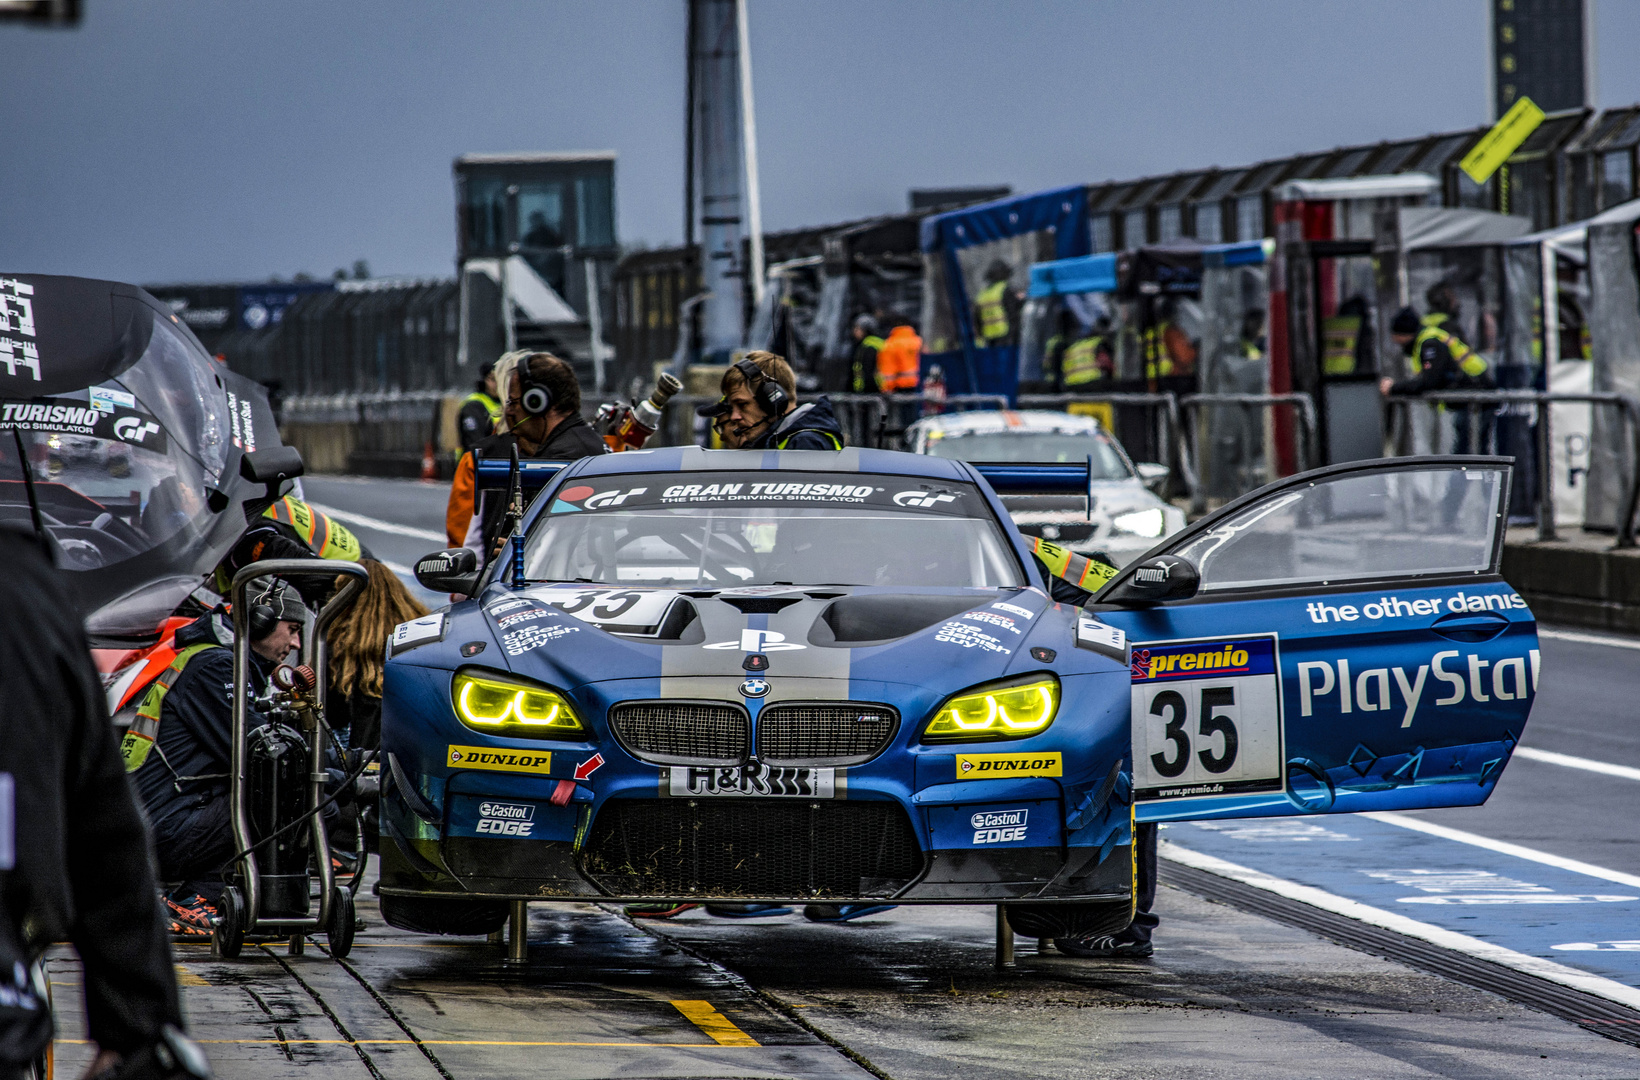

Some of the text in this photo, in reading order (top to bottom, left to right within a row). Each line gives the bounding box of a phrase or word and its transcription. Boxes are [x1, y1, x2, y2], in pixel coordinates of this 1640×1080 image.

[32, 422, 94, 435] SIMULATOR
[662, 483, 744, 498] GRAN
[786, 495, 865, 503] SIMULATOR
[550, 590, 658, 619] 35
[1307, 602, 1360, 624] the
[1362, 597, 1442, 620] other
[502, 625, 539, 640] the
[504, 624, 562, 645] other
[941, 625, 1001, 643] other
[946, 621, 982, 633] the
[506, 627, 580, 650] danish
[938, 630, 1011, 655] danish
[1148, 645, 1249, 679] premio
[1149, 686, 1239, 778] 35
[465, 752, 548, 768] DUNLOP
[977, 759, 1056, 771] DUNLOP
[688, 760, 768, 794] H&R
[1158, 784, 1224, 797] www.premio.de
[490, 804, 527, 819] Castrol
[984, 812, 1021, 827] Castrol
[475, 819, 535, 836] EDGE
[972, 826, 1029, 845] EDGE
